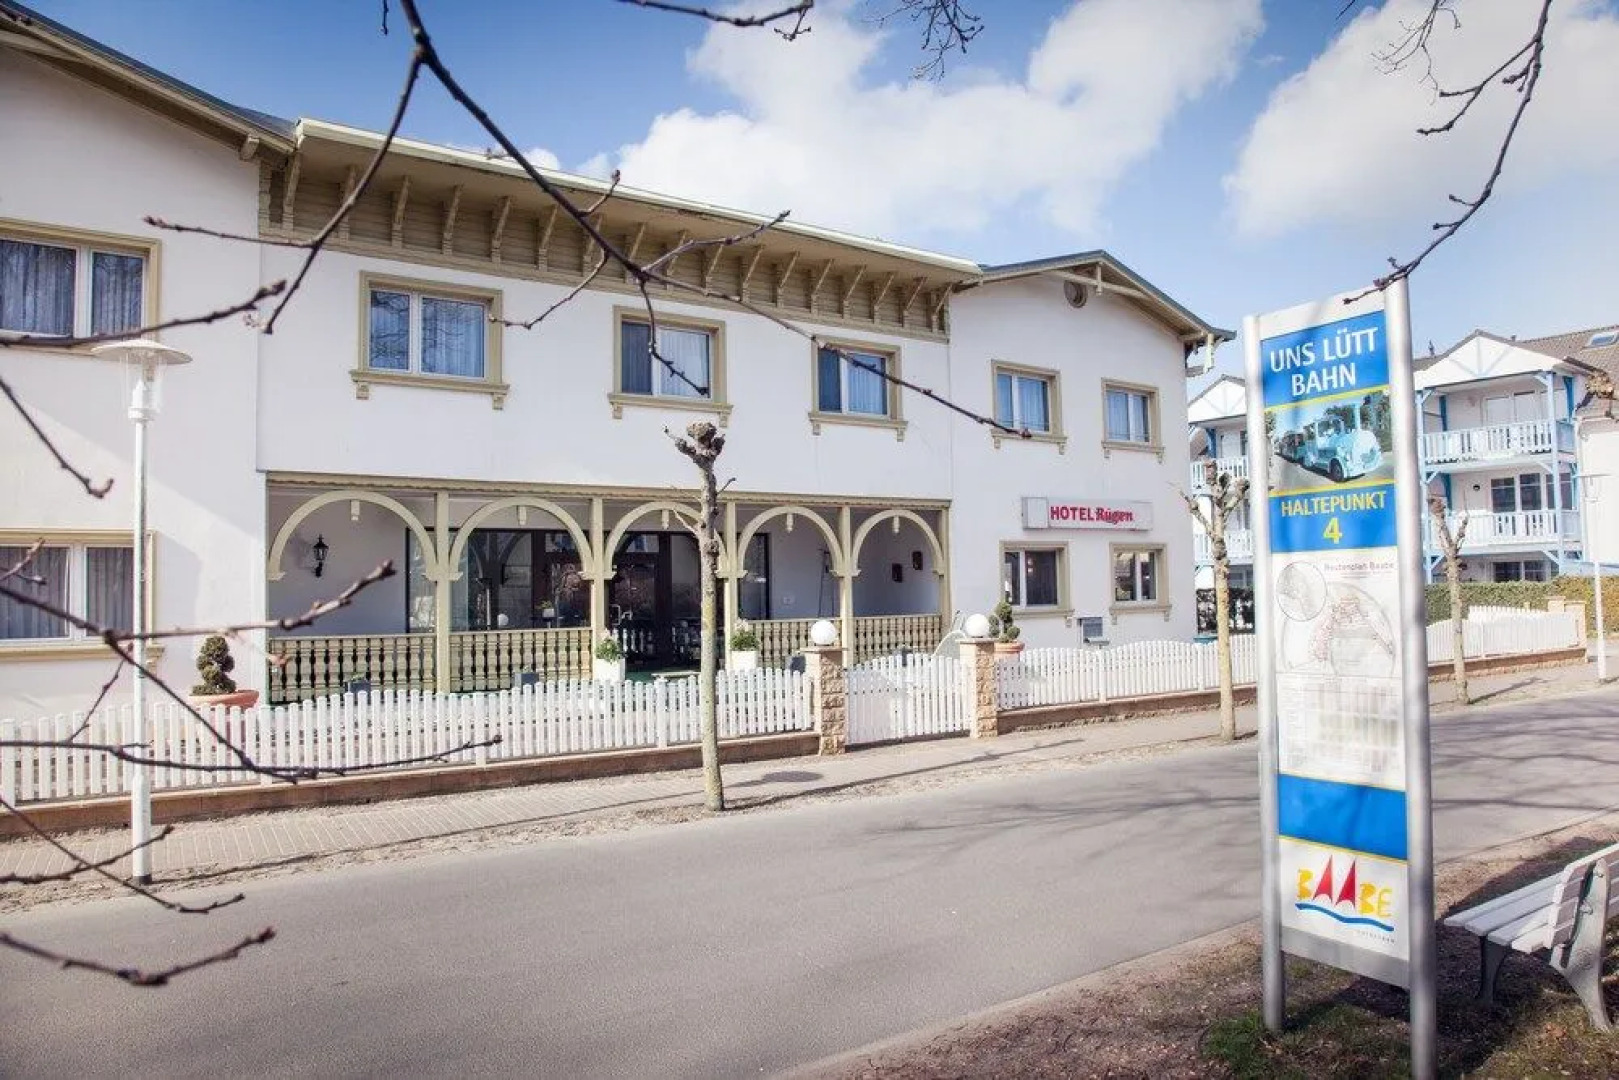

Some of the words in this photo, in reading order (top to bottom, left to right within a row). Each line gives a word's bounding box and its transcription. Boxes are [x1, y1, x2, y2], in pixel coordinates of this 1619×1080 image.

[1270, 342, 1316, 372] UNS
[1323, 327, 1378, 361] LÜTT
[1291, 362, 1356, 396] BAHN
[1050, 506, 1094, 521] HOTEL
[1095, 506, 1133, 525] Rügen
[1281, 490, 1387, 517] HALTEPUNKT
[1323, 517, 1343, 544] 4
[1297, 854, 1393, 917] BAABE
